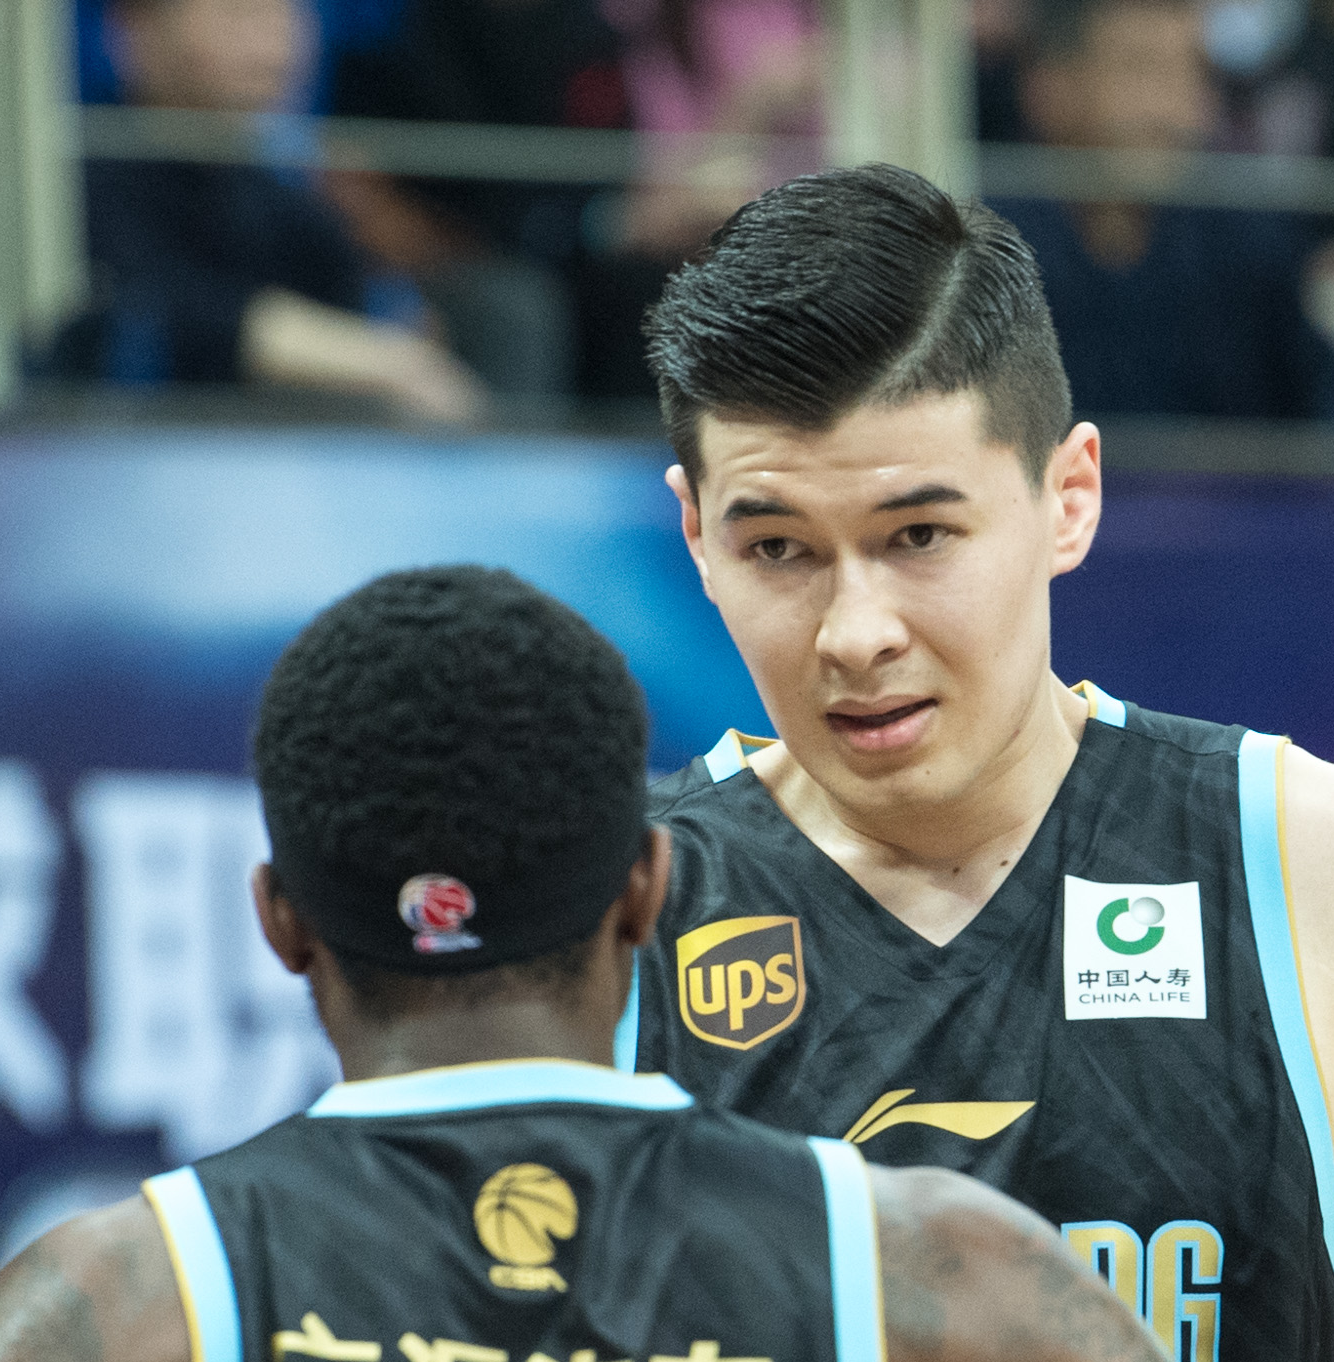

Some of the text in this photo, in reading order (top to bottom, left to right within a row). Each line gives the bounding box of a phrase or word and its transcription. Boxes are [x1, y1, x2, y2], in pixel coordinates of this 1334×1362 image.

[1078, 968, 1192, 988] 中国人寿
[689, 954, 794, 1031] ups
[1079, 992, 1191, 1004] CHINA LIFE
